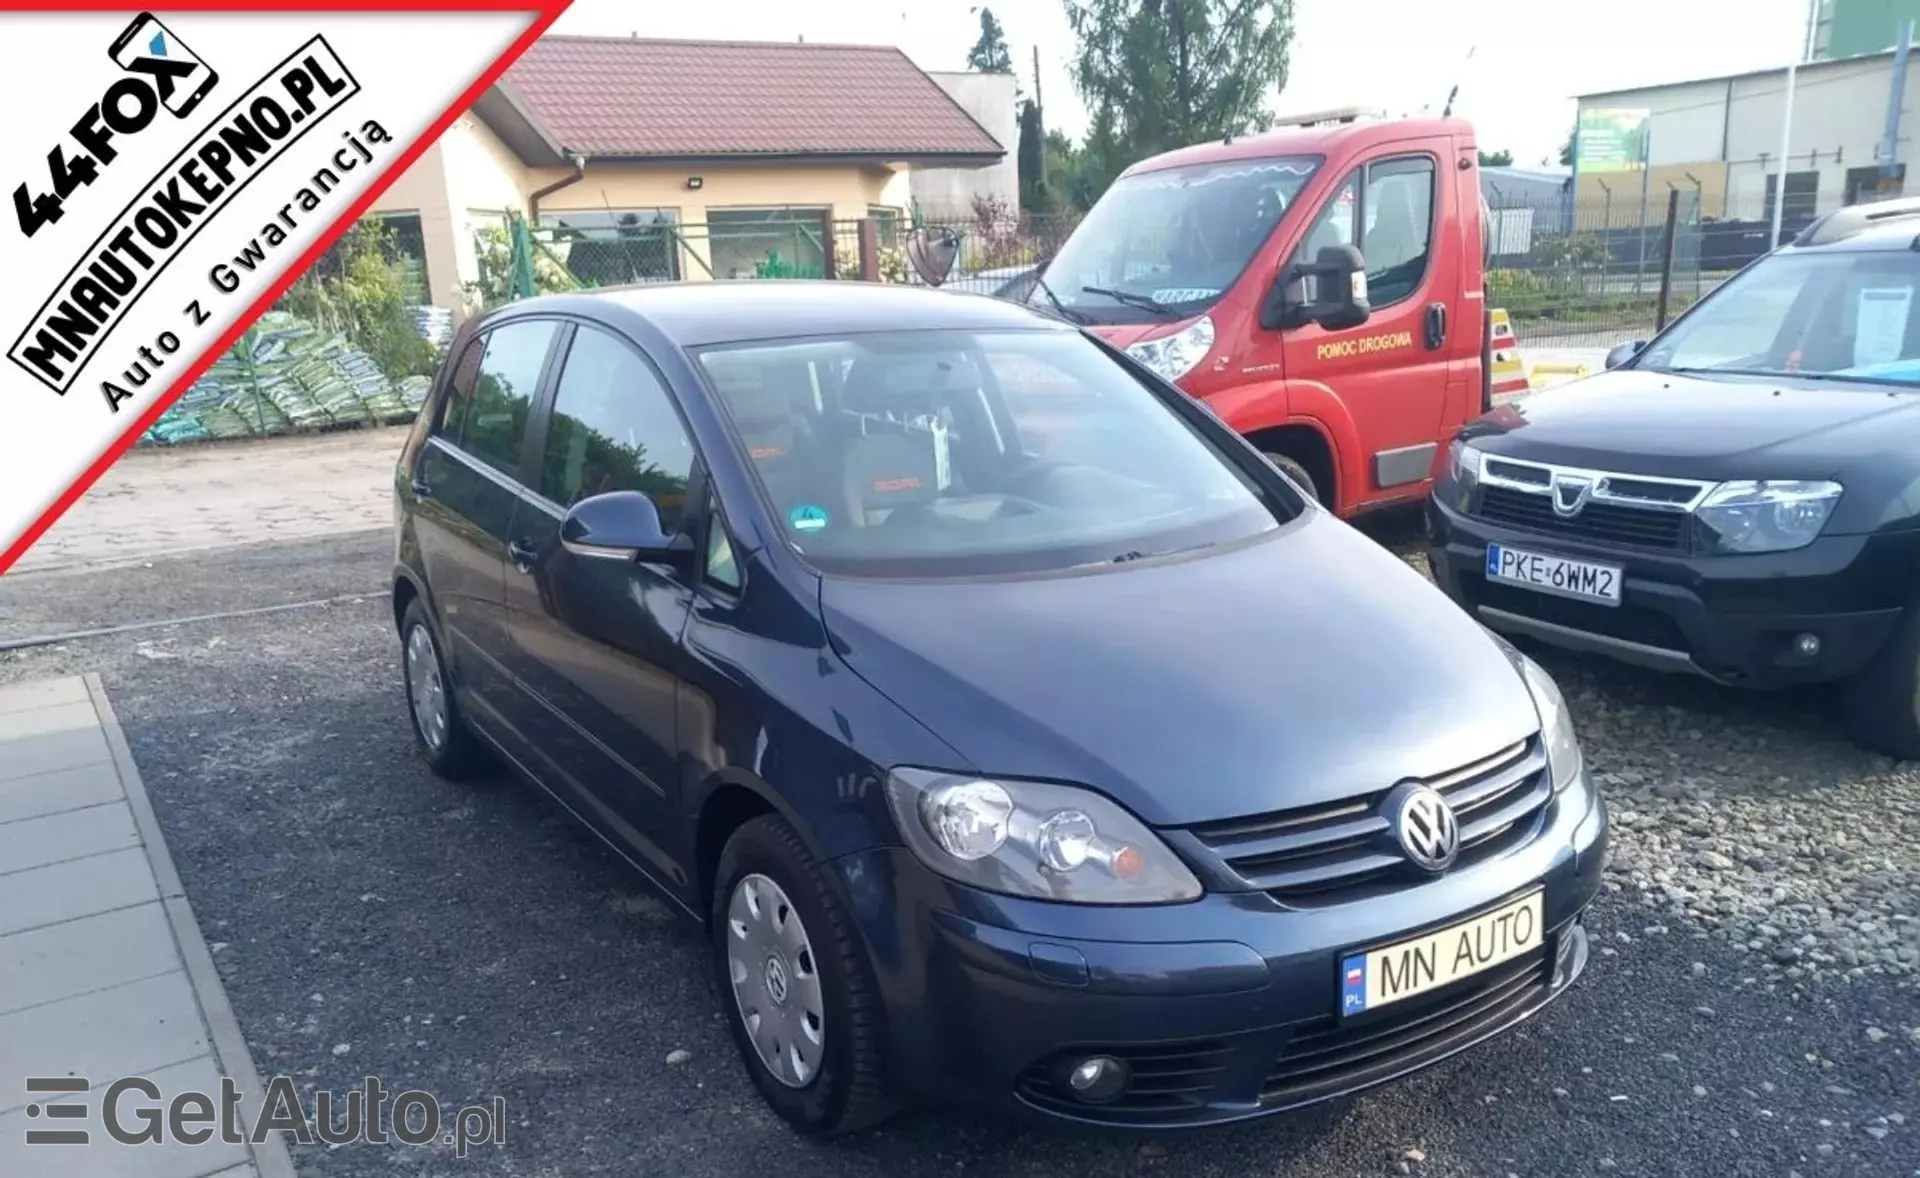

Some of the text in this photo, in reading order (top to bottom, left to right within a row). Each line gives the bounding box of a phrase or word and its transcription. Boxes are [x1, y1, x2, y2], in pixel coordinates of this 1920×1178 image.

[1317, 331, 1413, 360] POMOC DROGOWA
[1501, 550, 1613, 598] PKE 6WM2
[1380, 904, 1534, 999] MN AUTO
[1344, 993, 1363, 1008] PL
